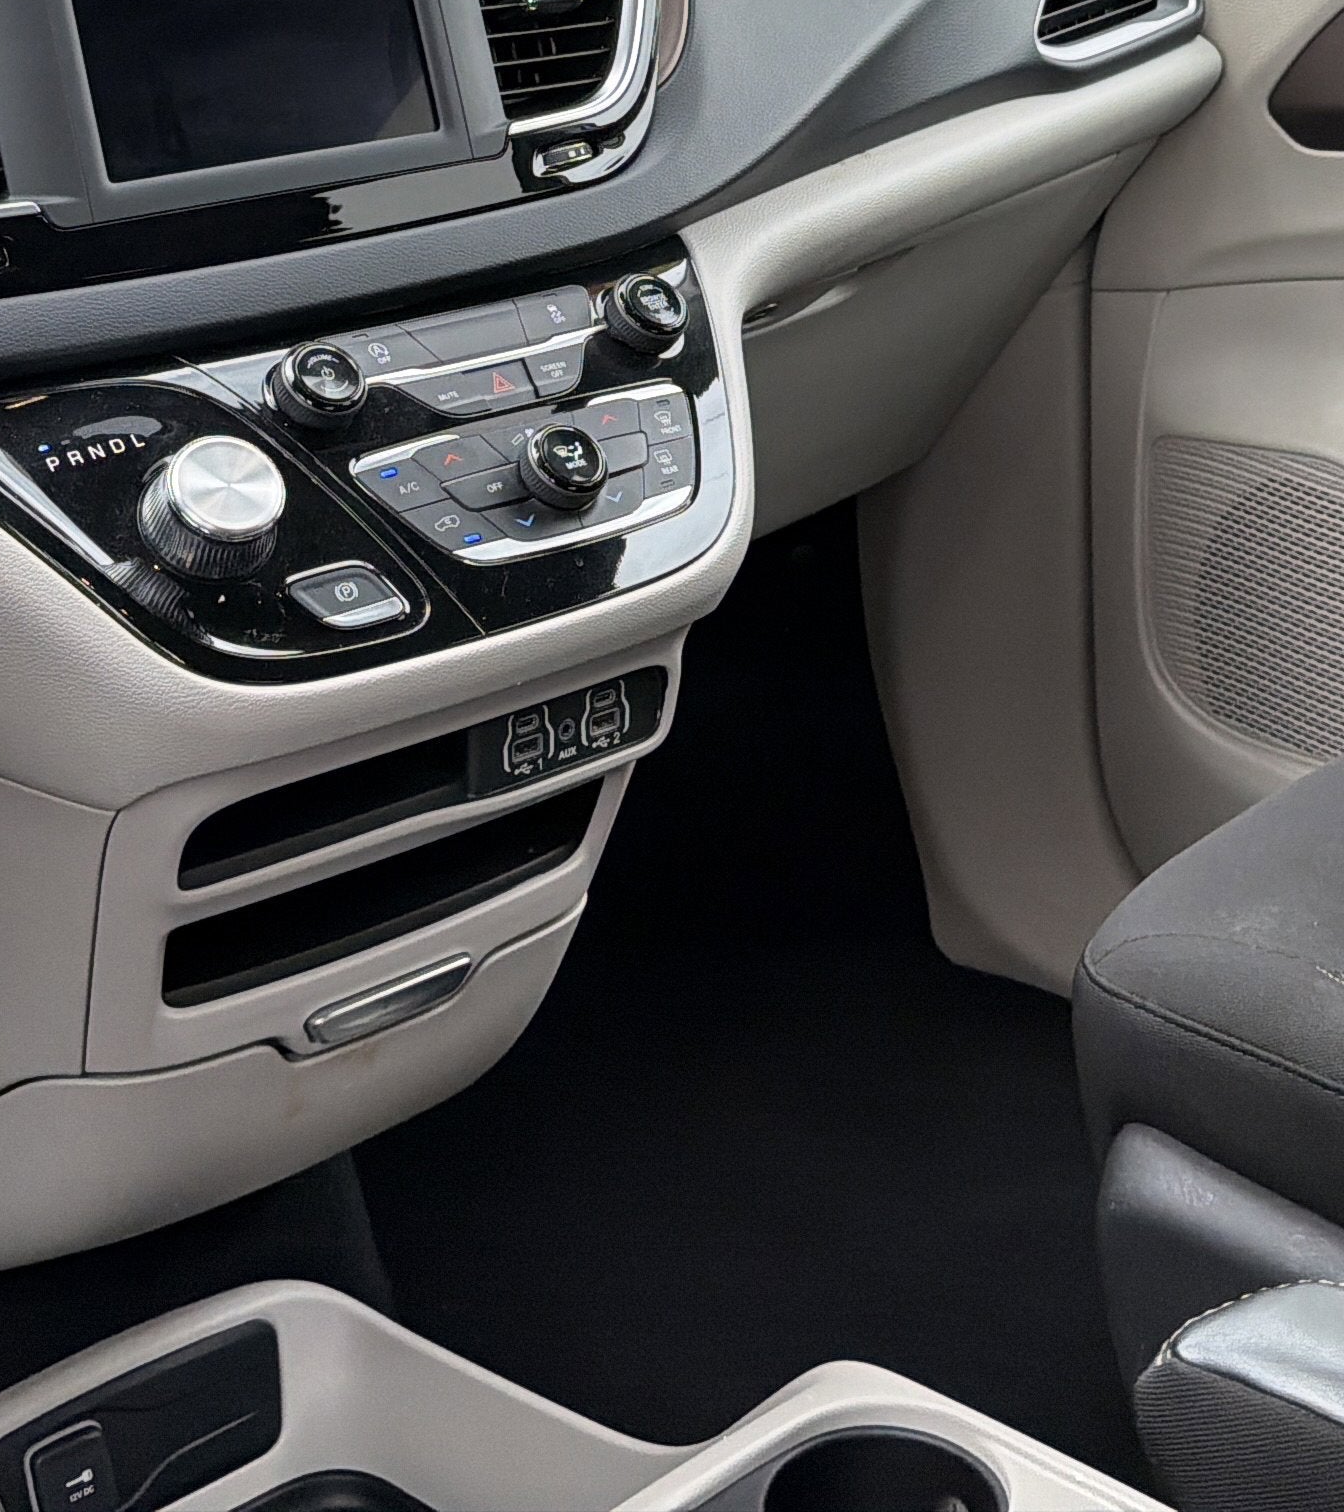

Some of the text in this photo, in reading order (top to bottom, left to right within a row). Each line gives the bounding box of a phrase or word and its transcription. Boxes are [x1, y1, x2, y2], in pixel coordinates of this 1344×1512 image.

[539, 360, 568, 373] SCREEN
[437, 390, 460, 403] MUTE
[660, 423, 682, 436] FRONT
[564, 457, 589, 471] MODE
[661, 464, 681, 476] REAR
[397, 480, 421, 496] A/C
[485, 480, 505, 494] OFF
[613, 731, 622, 745] 2
[558, 745, 577, 761] AUX
[536, 758, 544, 771] 1
[83, 1484, 95, 1497] DC
